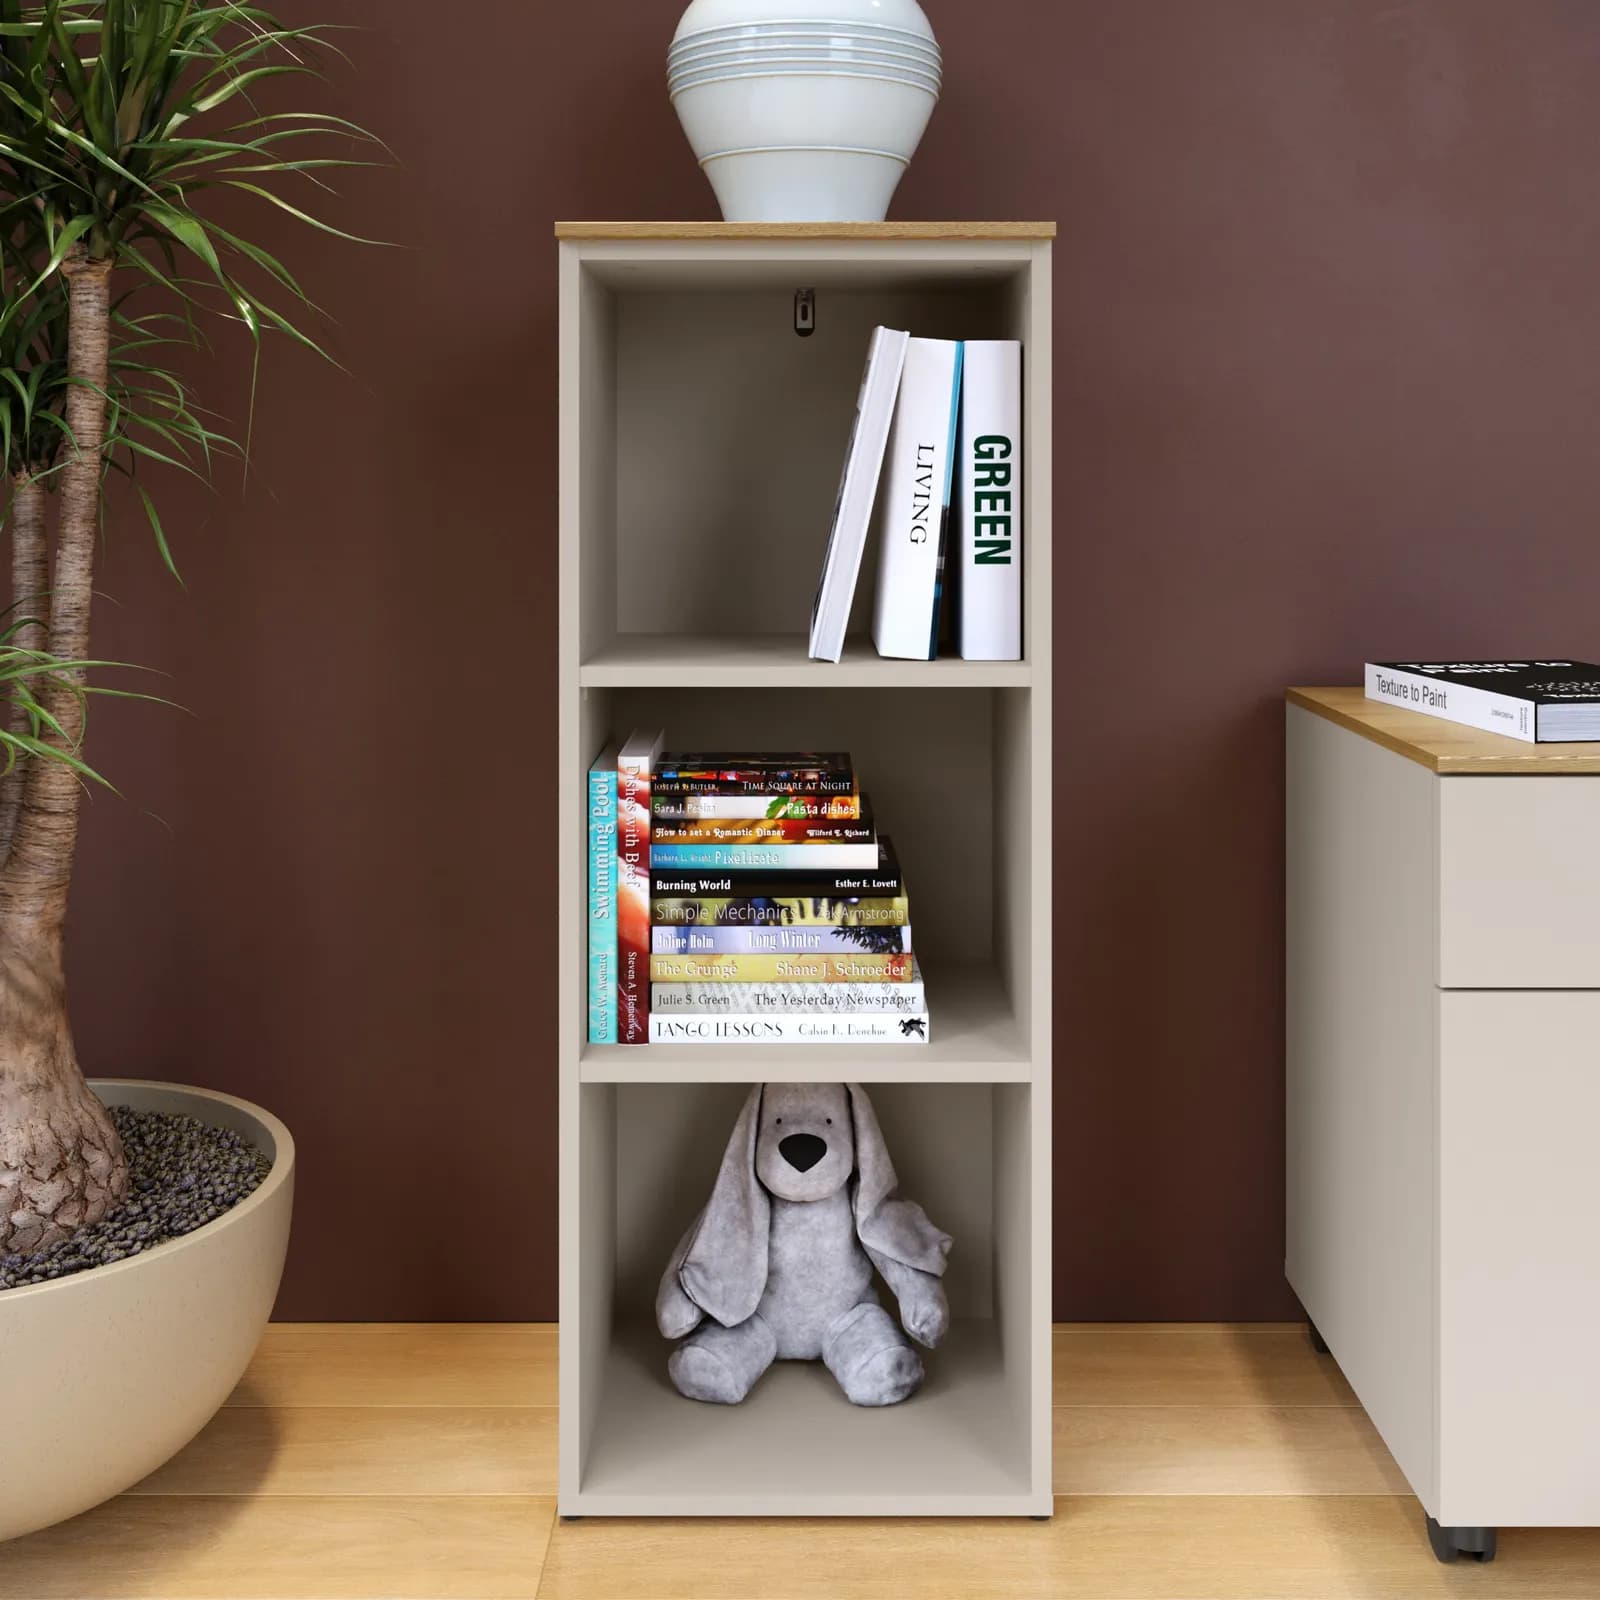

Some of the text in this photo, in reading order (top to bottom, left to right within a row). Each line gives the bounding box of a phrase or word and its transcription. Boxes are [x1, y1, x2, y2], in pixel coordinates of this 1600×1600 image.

[910, 443, 935, 545] LIVING
[973, 435, 1012, 565] GREEN
[1375, 674, 1447, 710] Texture to Paint
[742, 781, 851, 792] TIME SQUARE AT NIGHT
[654, 803, 675, 814] Sara
[787, 803, 856, 815] Pasta dishes
[625, 765, 641, 887] Dishes with Beef
[655, 829, 676, 838] How
[678, 829, 687, 837] to
[690, 829, 703, 837] set
[714, 828, 753, 839] Romantic
[756, 828, 785, 837] Dinner
[592, 777, 615, 919] Swimming Pool
[656, 879, 731, 893] Burning World
[835, 879, 897, 888] Esther E. Lovett
[656, 903, 796, 922] Simple Mechanics
[841, 905, 904, 922] Armstrong
[690, 934, 714, 949] Holm
[748, 930, 821, 950] Long Winter
[627, 951, 637, 980] Steven
[656, 961, 737, 978] The Grunge
[776, 961, 906, 977] Shane J. Schroeder
[657, 994, 730, 1007] Julie S. Green
[754, 993, 917, 1009] The Yesterday Newspaper
[656, 1022, 783, 1037] TANGO LESSONS
[798, 1023, 828, 1036] Calvin
